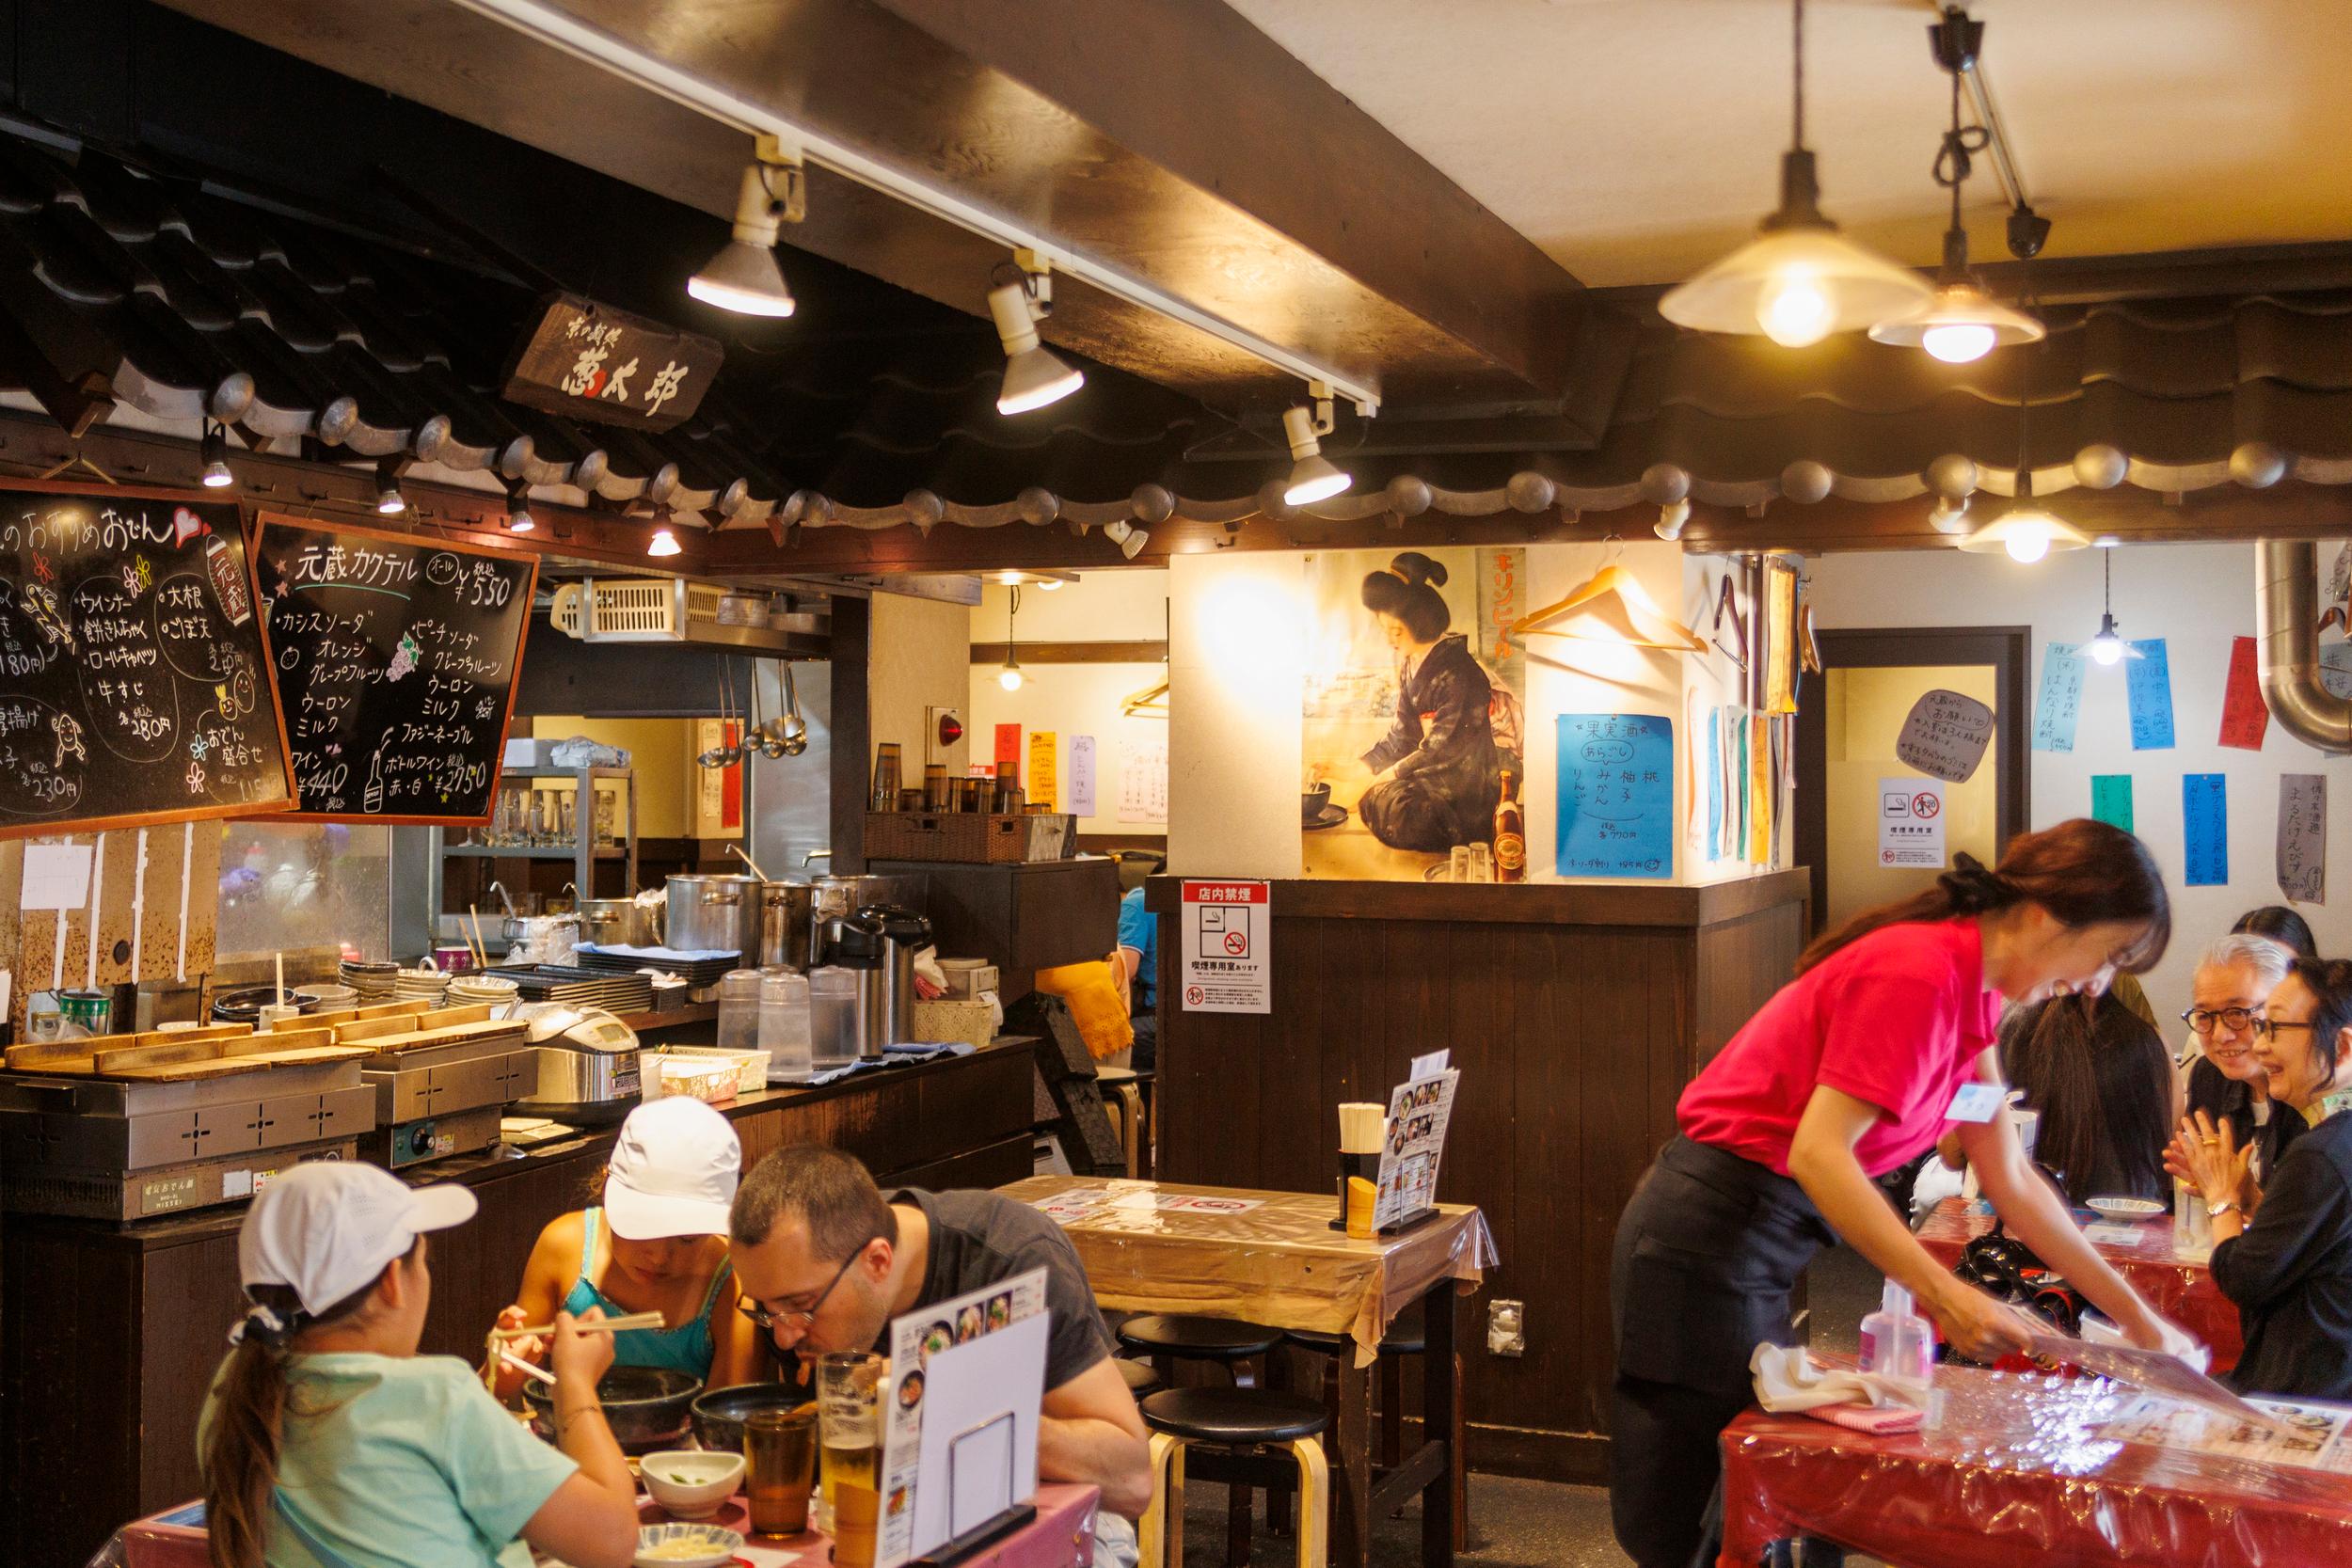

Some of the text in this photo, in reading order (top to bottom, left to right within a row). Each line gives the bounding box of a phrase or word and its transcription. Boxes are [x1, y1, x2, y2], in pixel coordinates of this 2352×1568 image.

[0, 509, 174, 555] のおすすめおでん
[294, 545, 418, 586] 元蔵カクテル
[81, 592, 133, 613] ウインナー
[167, 585, 204, 610] 大根
[1493, 553, 1514, 662] キリンビール
[83, 618, 148, 643] 餅きんちゃく
[169, 616, 213, 640] ごぼ天
[282, 610, 373, 634] カシスソーダ
[316, 637, 372, 658] オレンジ
[310, 663, 384, 687] グレープフルーツ
[435, 651, 501, 676] グレープフルーツ
[98, 679, 143, 706] 牛すじ
[428, 674, 474, 695] ウーロン
[302, 692, 352, 713] ウーロン
[421, 698, 460, 721] ミルク
[131, 718, 171, 741] 280円
[206, 727, 245, 748] おでん
[296, 716, 339, 737] ミルク
[1586, 721, 1638, 738] 果実酒
[222, 743, 263, 767] 盛合せ
[385, 754, 444, 773] ボトルワイン
[1586, 747, 1627, 758] あらごし
[32, 776, 77, 802] 230円
[1573, 768, 1586, 806] りんご
[1596, 769, 1611, 805] みかん
[1620, 770, 1635, 802] 柚子
[1642, 771, 1660, 783] 桃
[1199, 887, 1251, 902] 店内禁煙
[1192, 961, 1259, 972] 喫煙専用室あります
